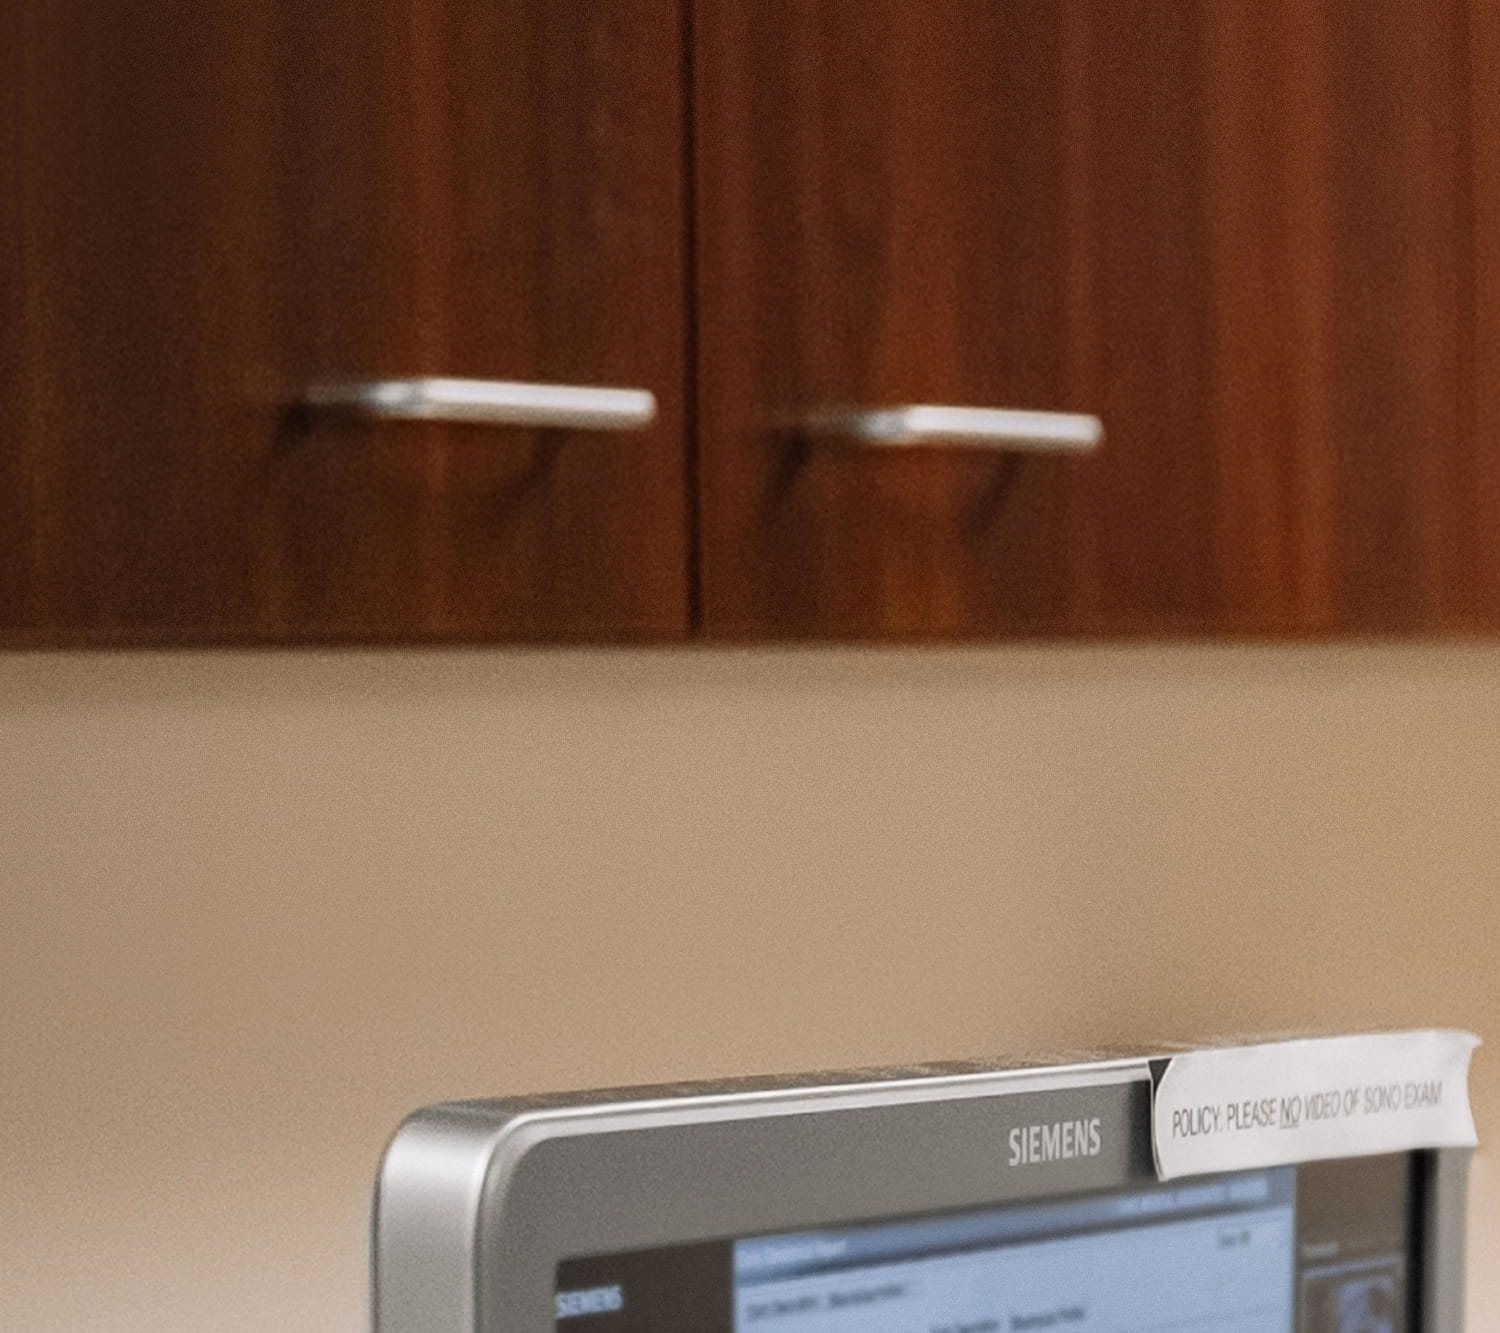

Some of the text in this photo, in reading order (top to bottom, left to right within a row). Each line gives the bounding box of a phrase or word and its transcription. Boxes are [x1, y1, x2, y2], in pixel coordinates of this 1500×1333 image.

[1173, 1105, 1223, 1138] POLICY:
[1227, 1098, 1277, 1131] PLEASE
[1280, 1095, 1302, 1129] NO
[1304, 1089, 1342, 1121] VIDEO
[1343, 1087, 1360, 1117] OF
[1403, 1079, 1443, 1110] EXAM
[1008, 1117, 1101, 1167] SIEMENS
